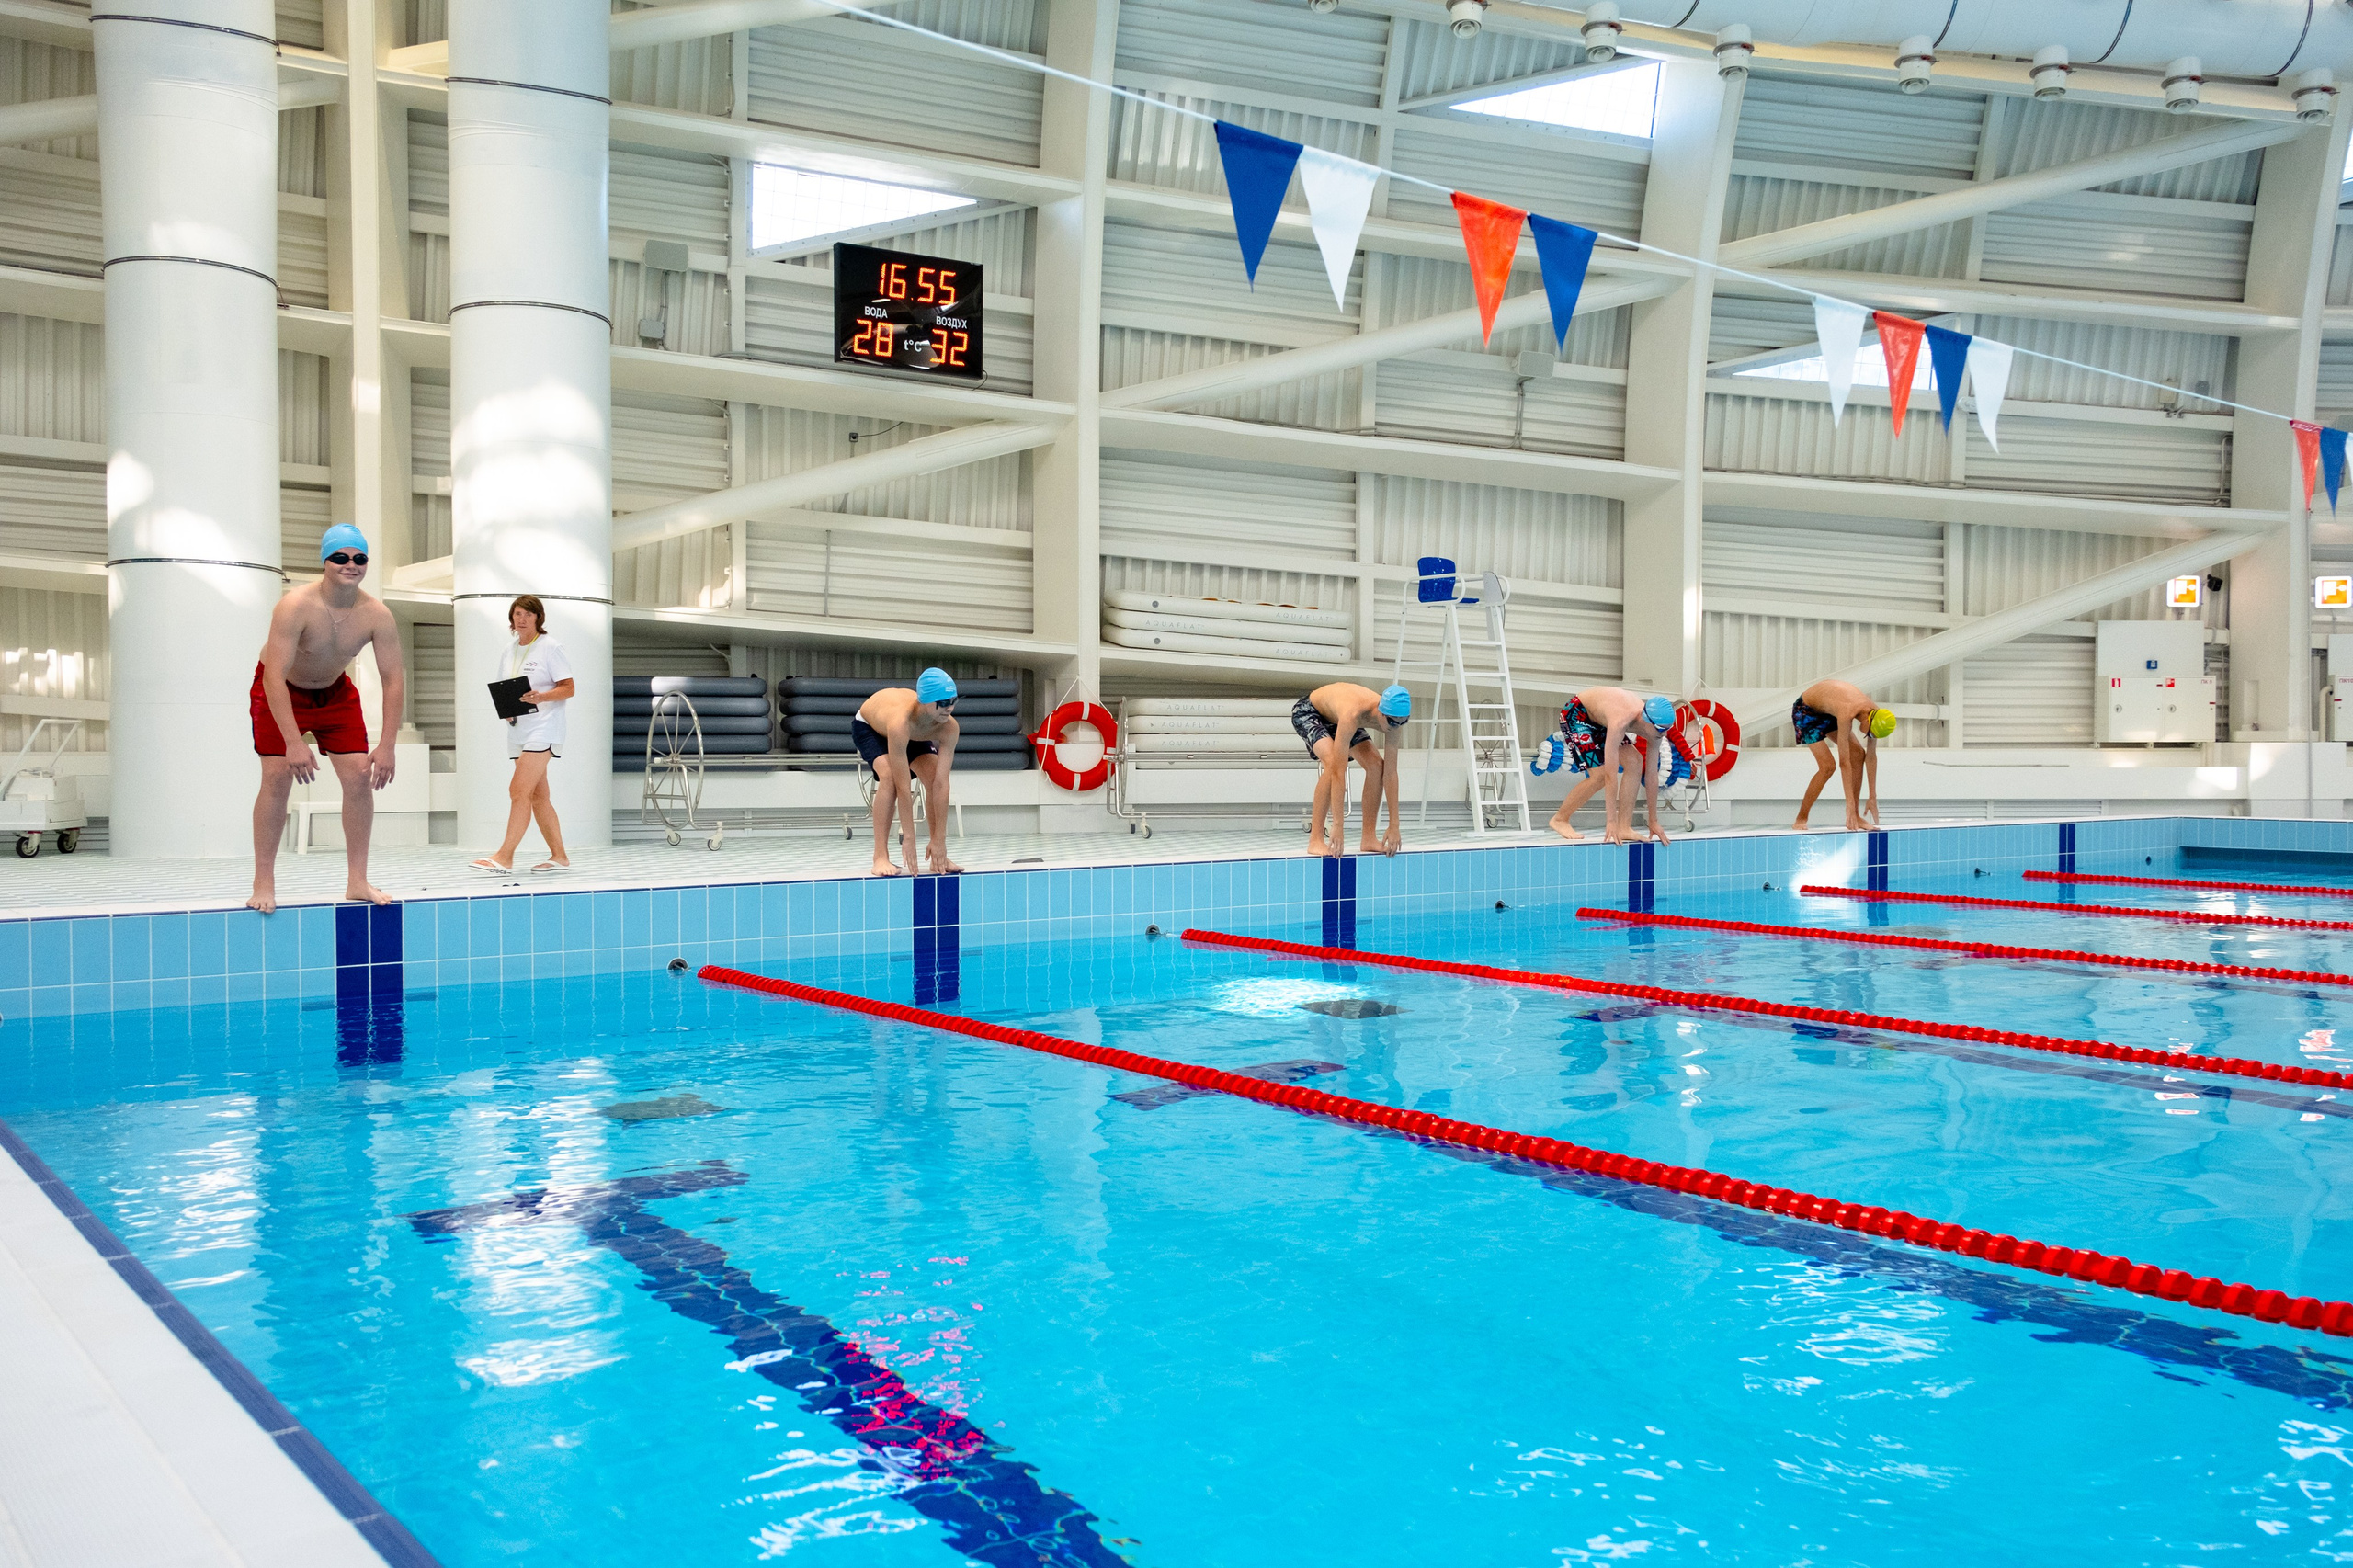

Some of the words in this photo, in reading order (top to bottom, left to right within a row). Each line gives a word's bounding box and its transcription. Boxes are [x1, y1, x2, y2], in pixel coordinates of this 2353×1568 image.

[864, 306, 888, 319] ВОДА
[936, 315, 967, 329] ВОЗДУХ
[853, 318, 894, 358] 28
[930, 328, 969, 367] 32
[1276, 612, 1330, 622] AQUAFLAT
[1145, 620, 1201, 630] AQUAFLAT
